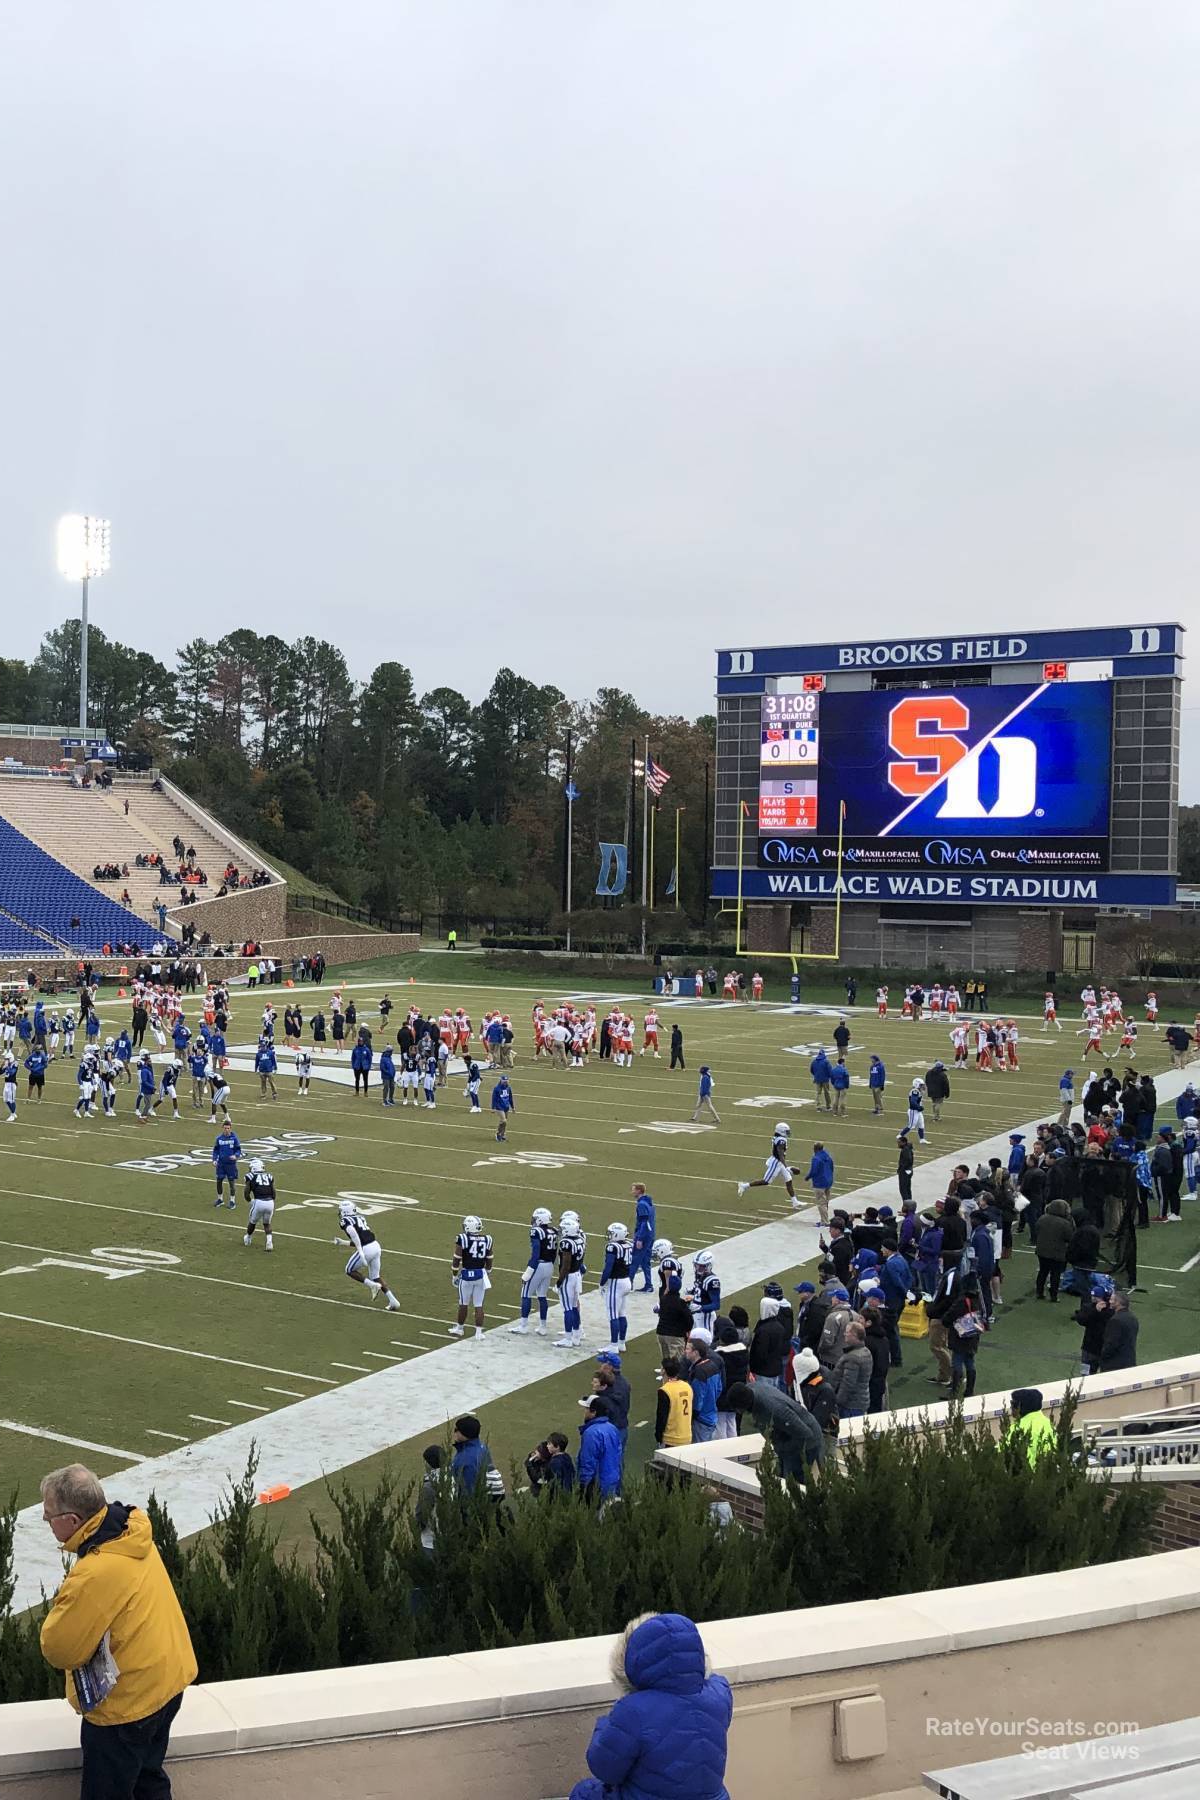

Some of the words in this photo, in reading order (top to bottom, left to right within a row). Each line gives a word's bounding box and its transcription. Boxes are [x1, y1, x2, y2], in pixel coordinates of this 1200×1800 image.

[1129, 628, 1160, 653] D
[839, 643, 942, 666] BROOKS
[952, 639, 1028, 660] FIELD
[729, 652, 754, 674] D
[1046, 663, 1066, 679] 25
[804, 675, 823, 690] 25
[766, 695, 816, 712] 31:08
[782, 712, 811, 720] QUARTER
[771, 744, 780, 758] 0
[799, 743, 808, 757] 0
[888, 695, 970, 797] S
[935, 736, 1037, 818] D
[784, 782, 793, 794] S
[762, 798, 786, 806] PLAYS
[762, 808, 786, 816] YARDS
[800, 808, 805, 816] 0
[796, 817, 808, 825] 0.0
[763, 839, 820, 864] OMSA
[924, 839, 988, 864] OMSA
[768, 875, 880, 894] WALLACE
[887, 876, 962, 896] WADE
[971, 877, 1098, 899] STADIUM
[489, 1151, 588, 1169] 30
[255, 1173, 270, 1186] 49
[303, 1191, 420, 1216] 20
[469, 1240, 487, 1258] 43
[33, 1246, 183, 1280] 10
[682, 1399, 689, 1416] 2
